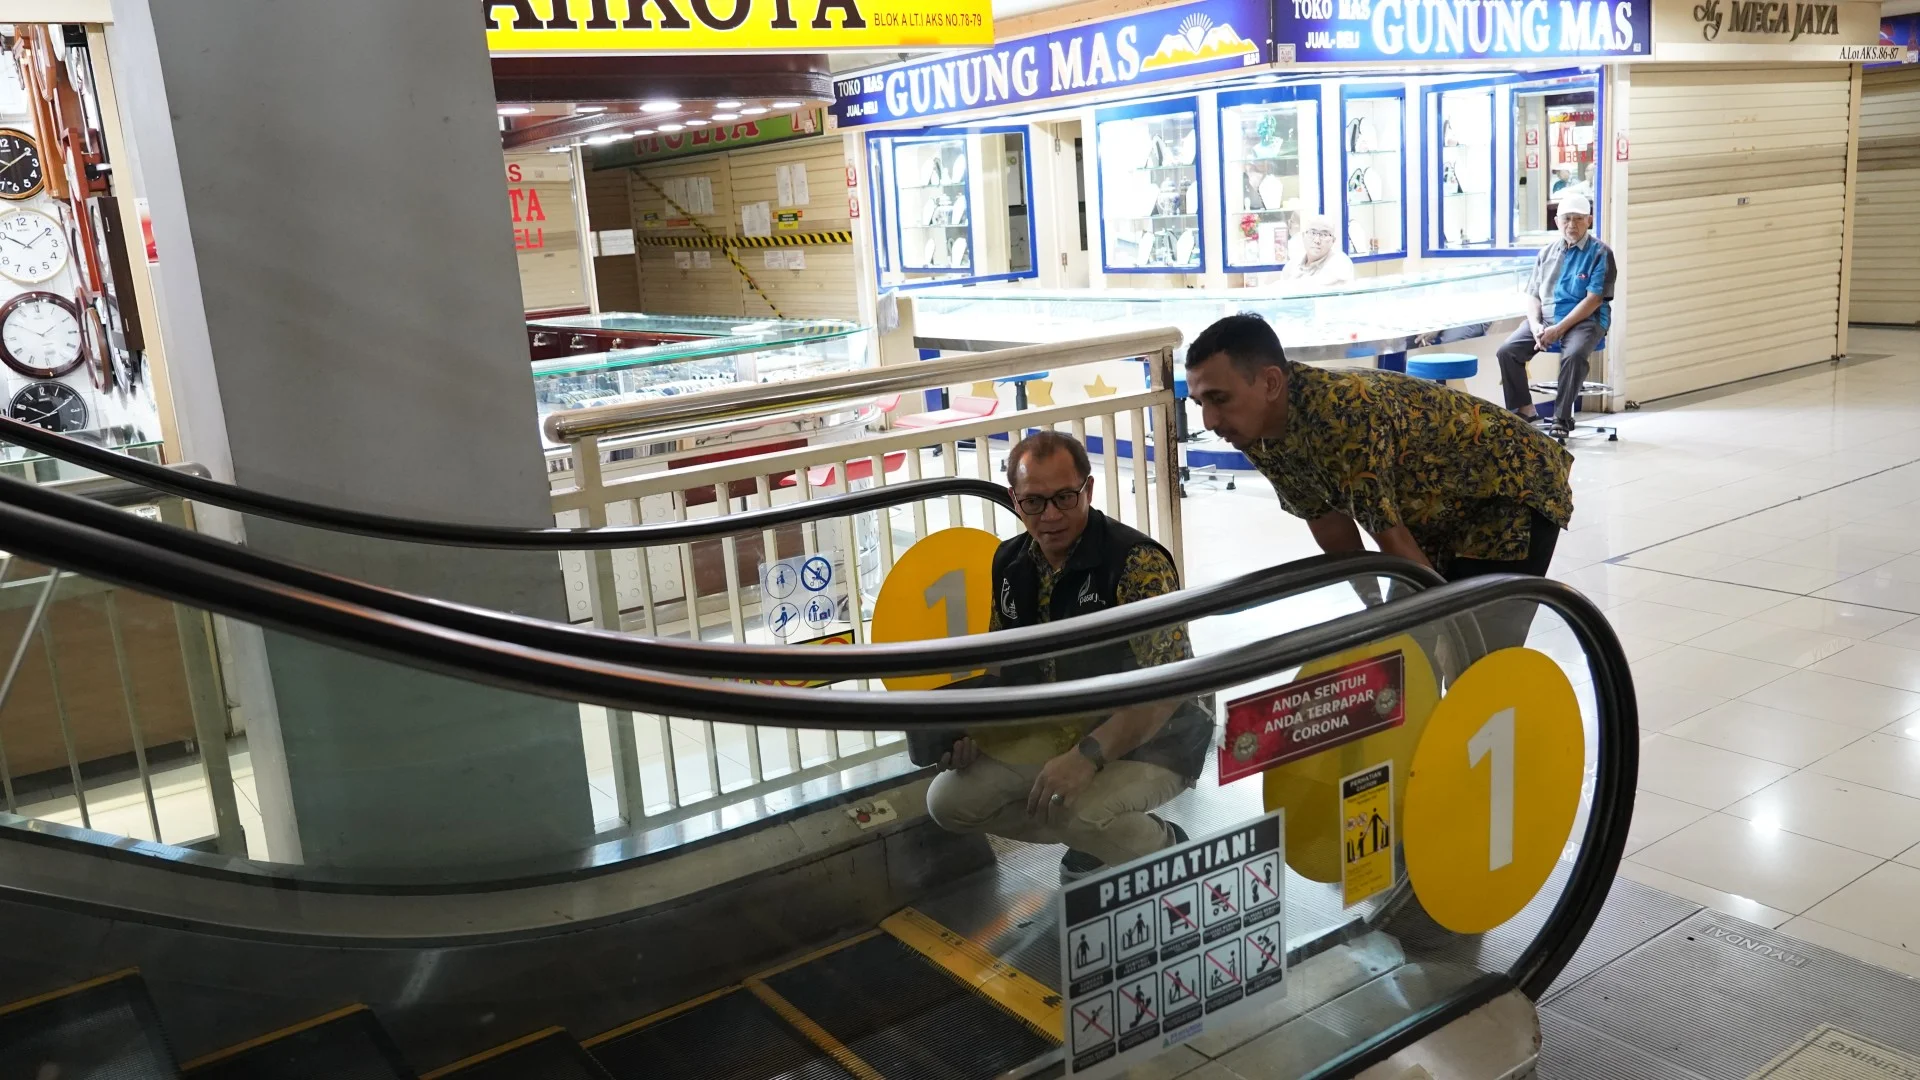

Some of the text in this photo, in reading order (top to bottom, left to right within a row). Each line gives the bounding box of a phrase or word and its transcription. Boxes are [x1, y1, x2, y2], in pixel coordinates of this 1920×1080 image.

[874, 13, 899, 26] BLOK
[902, 13, 908, 26] A
[926, 13, 943, 26] AKS
[945, 13, 982, 27] NO.78-79
[1292, 0, 1371, 20] TOKO MAS
[1371, 0, 1634, 54] GUNUNG MAS
[1728, 1, 1839, 42] MEGA JAYA
[838, 74, 884, 97] TOKO MAS
[886, 25, 1140, 117] GUNUNG MAS
[924, 568, 974, 680] 1
[1264, 689, 1375, 735] ANDA TERPAPAR
[1272, 674, 1367, 714] ANDA SENTUH
[1292, 715, 1350, 743] CORONA
[1467, 706, 1516, 871] 1
[1100, 828, 1256, 909] PERHATIAN!
[1705, 926, 1806, 966] HYUNDAI
